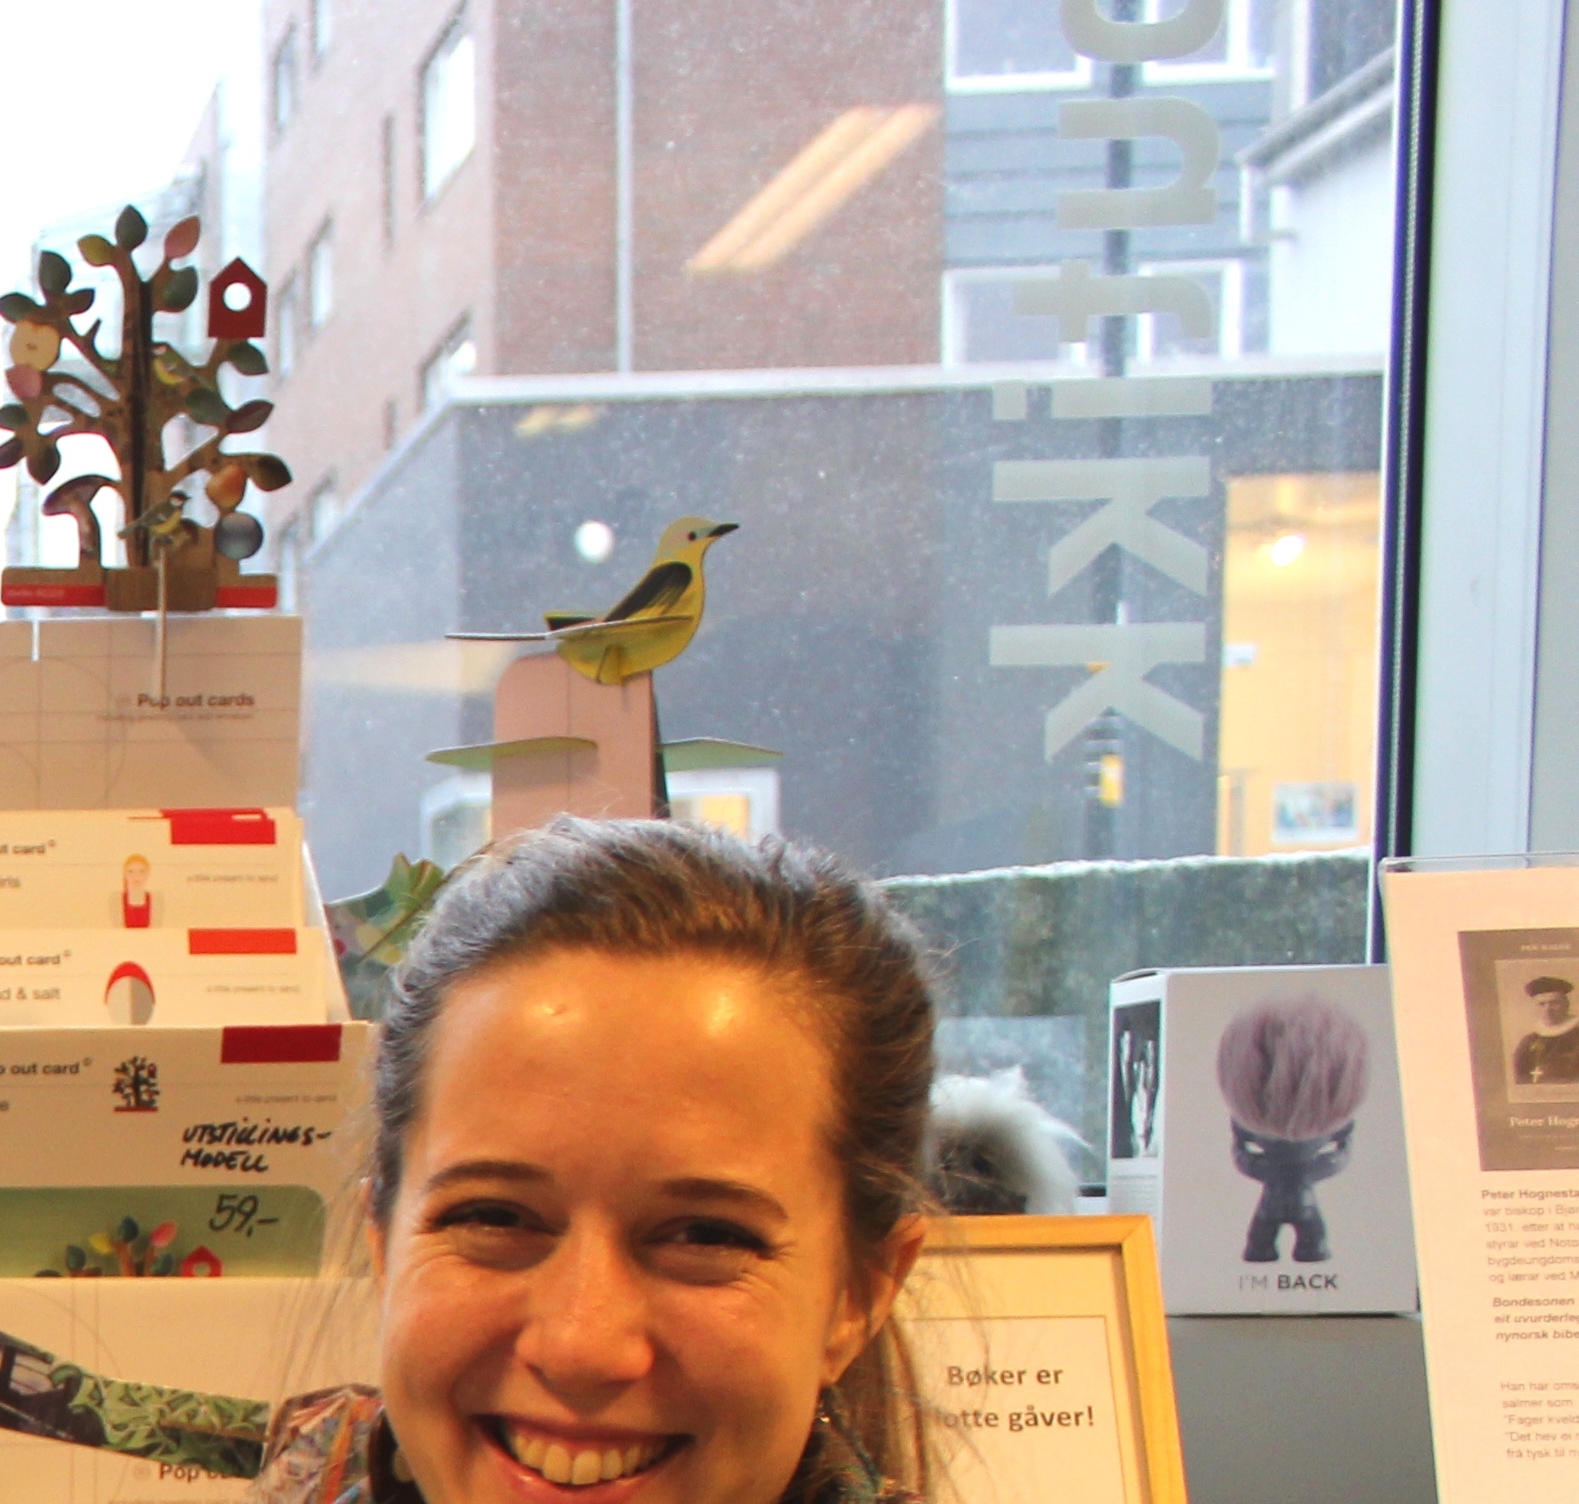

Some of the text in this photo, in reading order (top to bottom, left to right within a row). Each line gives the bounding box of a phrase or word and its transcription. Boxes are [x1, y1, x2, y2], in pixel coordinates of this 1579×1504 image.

[13, 842, 46, 855] card
[27, 952, 61, 966] card
[15, 987, 27, 1000] &
[31, 987, 61, 1000] salt
[10, 1062, 38, 1075] out
[42, 1061, 80, 1075] card
[1481, 1190, 1515, 1200] Peter
[1277, 1274, 1338, 1290] BACK
[1496, 1330, 1548, 1342] nynorsk
[947, 1365, 1063, 1387] Bøker er
[1008, 1404, 1095, 1432] gåver!
[159, 1463, 199, 1483] Pop
